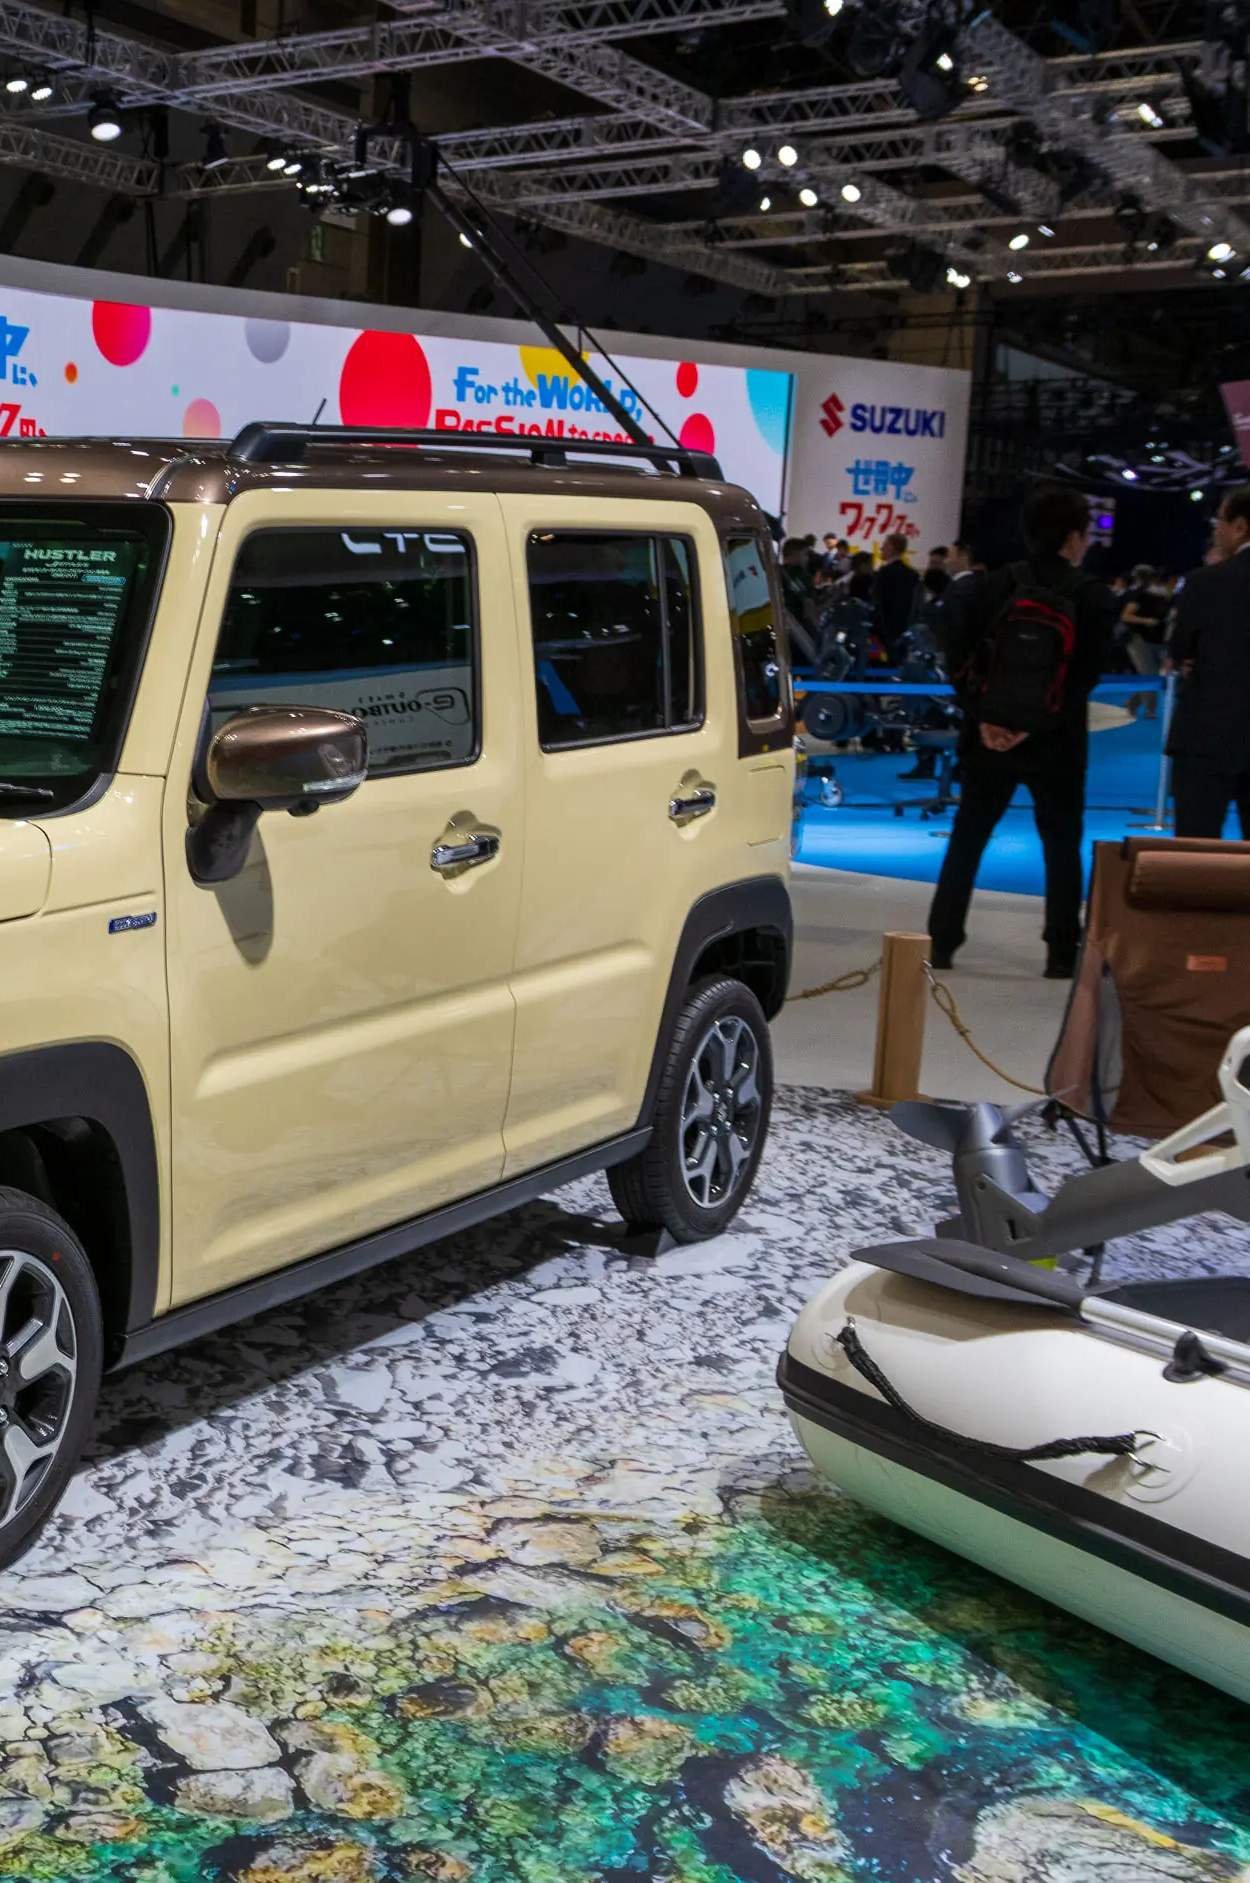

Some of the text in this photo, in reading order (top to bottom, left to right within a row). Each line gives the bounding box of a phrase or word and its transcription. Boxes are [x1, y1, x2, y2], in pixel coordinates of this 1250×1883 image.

[453, 366, 499, 405] For
[502, 377, 538, 409] the
[850, 403, 946, 438] SUZUKI
[23, 548, 118, 563] HUSTLER
